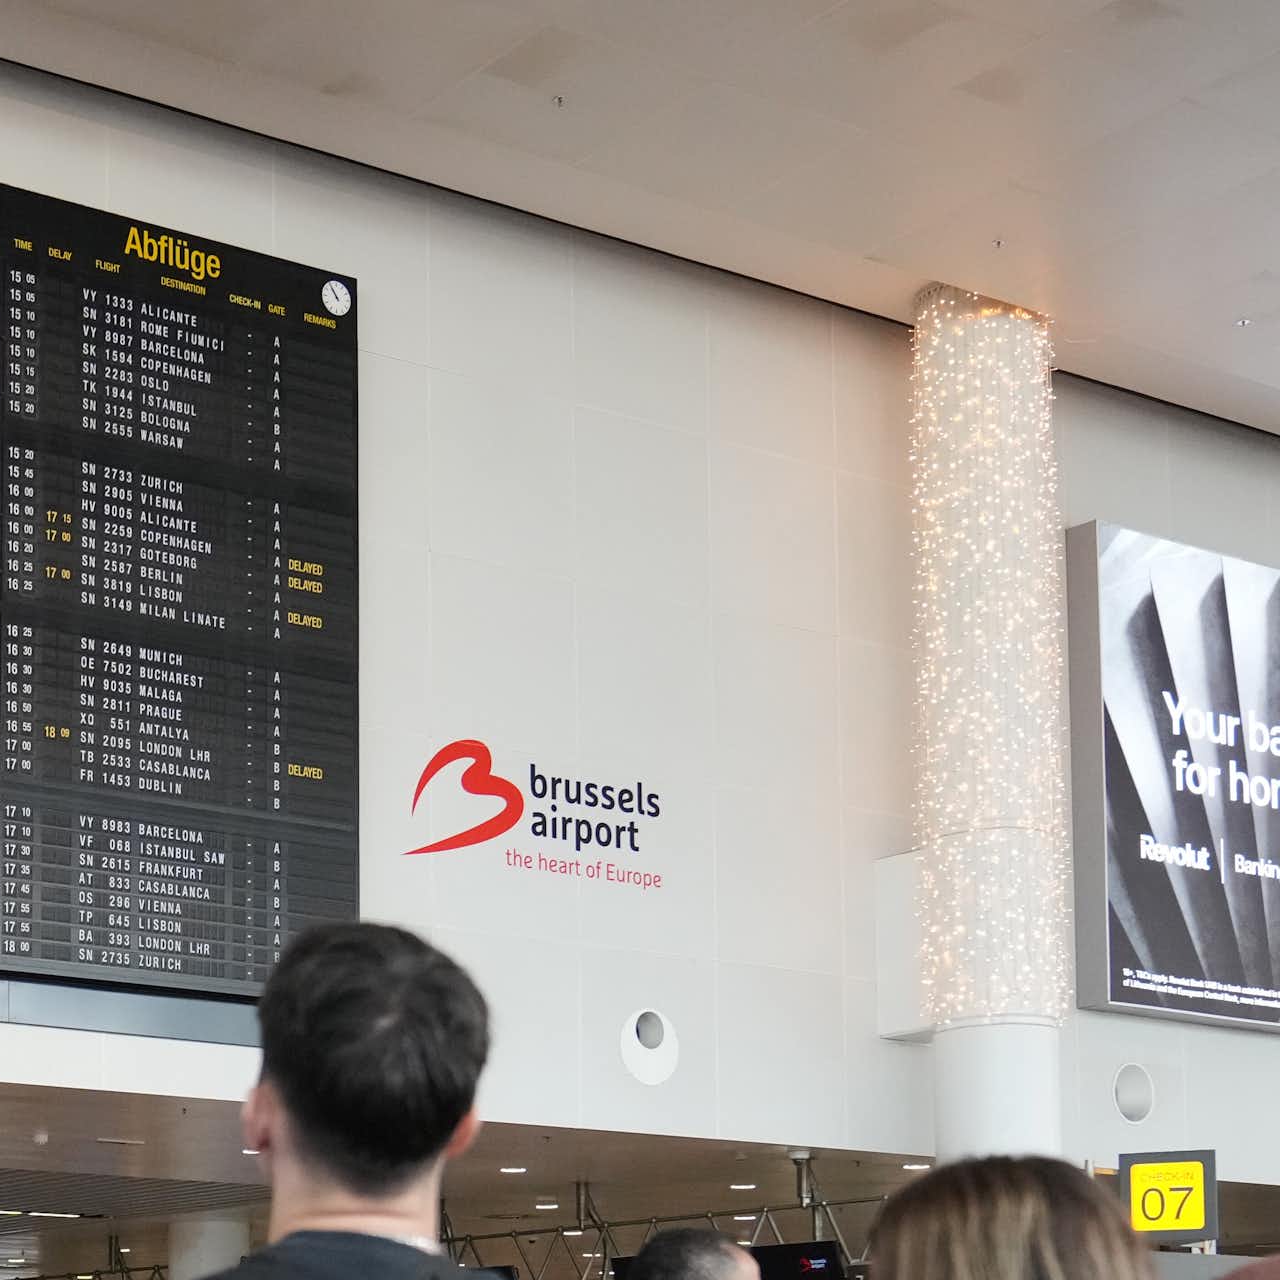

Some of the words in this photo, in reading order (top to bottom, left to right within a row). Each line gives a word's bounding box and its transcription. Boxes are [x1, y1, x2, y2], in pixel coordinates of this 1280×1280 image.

[124, 226, 221, 280] Abflüge
[14, 238, 32, 251] TIME
[48, 247, 72, 261] DELAY
[96, 259, 120, 273] FLIGHT
[160, 276, 206, 296] DESTINATION
[229, 294, 261, 310] CHECK-IN
[268, 304, 285, 316] GATE
[304, 313, 336, 329] REMARKS
[141, 474, 182, 494] ZURICH
[140, 511, 196, 533] ALICANTE
[140, 529, 211, 554] COPENHAGEN
[288, 559, 323, 576] DELAYED
[140, 548, 197, 569] GOTEBORG
[140, 566, 182, 584] BERLIN
[140, 666, 203, 688] BUCHAREST
[139, 684, 182, 702] MALAGA
[140, 703, 182, 721] PRAGUE
[1162, 690, 1241, 747] Your
[139, 722, 189, 740] ANTALYA
[139, 759, 210, 780] CASABLANCA
[140, 740, 182, 758] LONDON
[190, 748, 210, 762] LHR
[288, 764, 322, 780] DELAYED
[1172, 749, 1221, 798] for
[530, 763, 661, 818] brussels
[138, 824, 203, 844] BARCELONA
[530, 804, 640, 852] airport
[1140, 834, 1211, 872] Revolut
[139, 861, 202, 880] FRANKFURT
[505, 848, 533, 869] the
[538, 852, 581, 877] heart
[586, 861, 602, 880] of
[606, 863, 662, 890] Europe
[139, 954, 181, 970] ZURICH
[1141, 1187, 1194, 1221] 07
